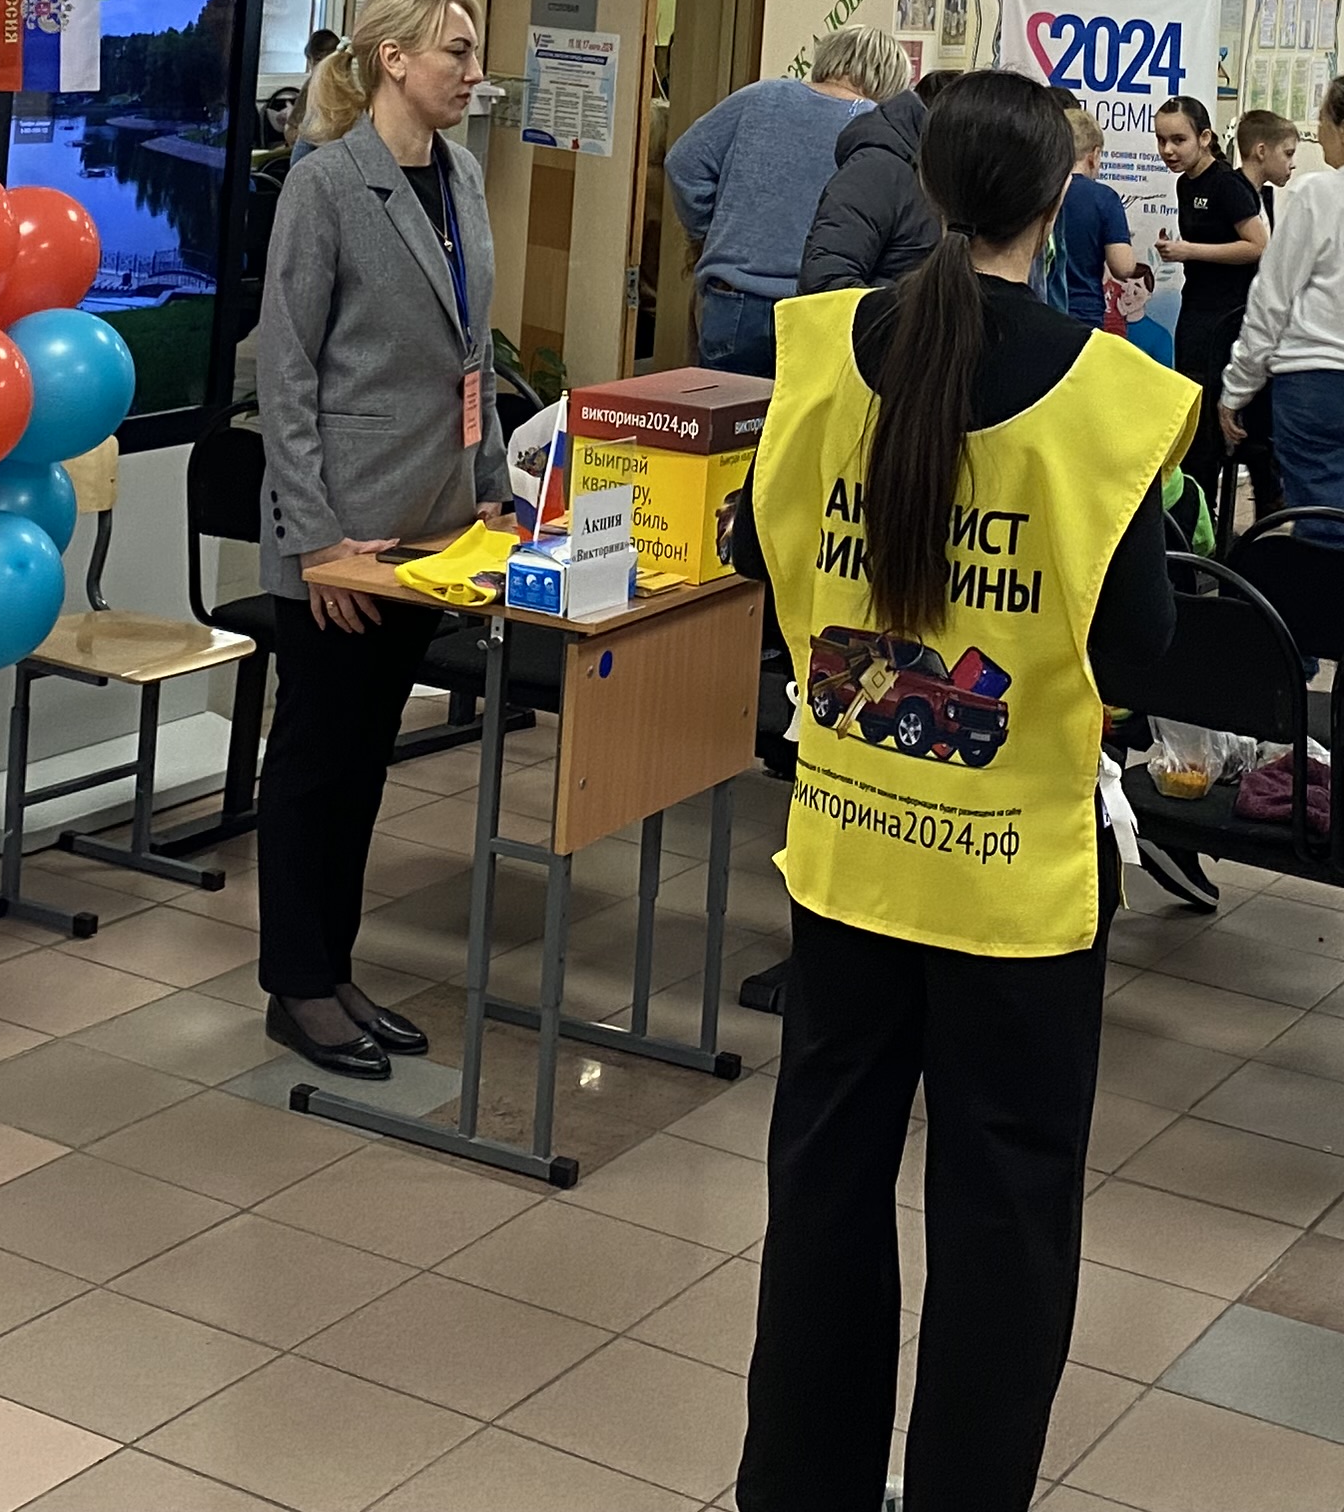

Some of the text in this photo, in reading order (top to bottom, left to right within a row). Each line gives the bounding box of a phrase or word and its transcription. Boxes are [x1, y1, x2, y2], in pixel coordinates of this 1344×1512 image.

[1048, 13, 1186, 96] 2024
[1143, 204, 1178, 216] В.В. Пути
[581, 405, 699, 439] викторина2024.рф
[584, 446, 649, 475] Выиграй
[581, 512, 623, 535] Акция
[571, 540, 630, 565] «Викторина»
